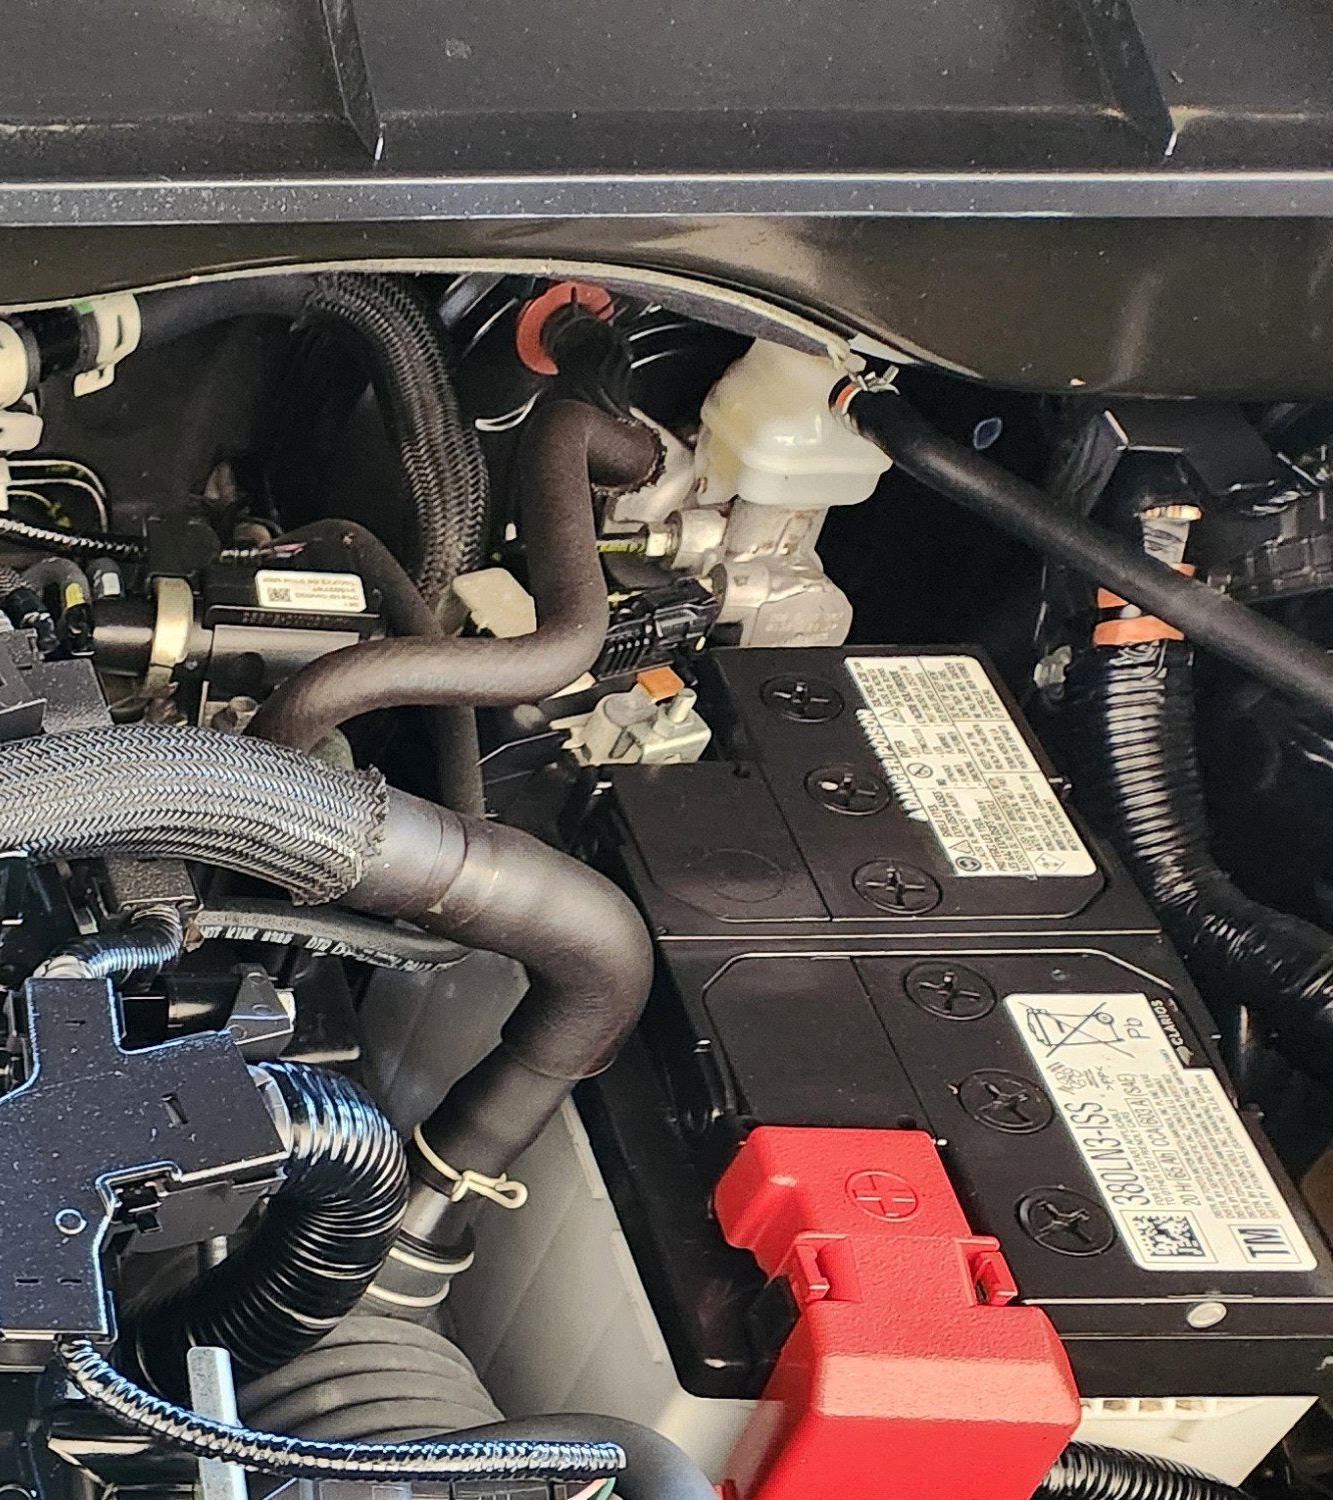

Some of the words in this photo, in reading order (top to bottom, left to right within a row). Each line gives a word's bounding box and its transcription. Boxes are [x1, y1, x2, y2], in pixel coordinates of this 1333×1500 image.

[1119, 1016, 1151, 1040] Pb
[1147, 998, 1186, 1045] CLARIOS
[1114, 1073, 1147, 1096] (SAE)
[1143, 1127, 1172, 1146] CCA
[1061, 1101, 1152, 1205] 380LN3-ISS
[1126, 1145, 1145, 1166] START
[1156, 1151, 1181, 1164] Ah
[1164, 1166, 1188, 1178] 65
[1171, 1180, 1195, 1192] Hr
[1178, 1194, 1202, 1205] 20
[1235, 1227, 1293, 1258] TM
